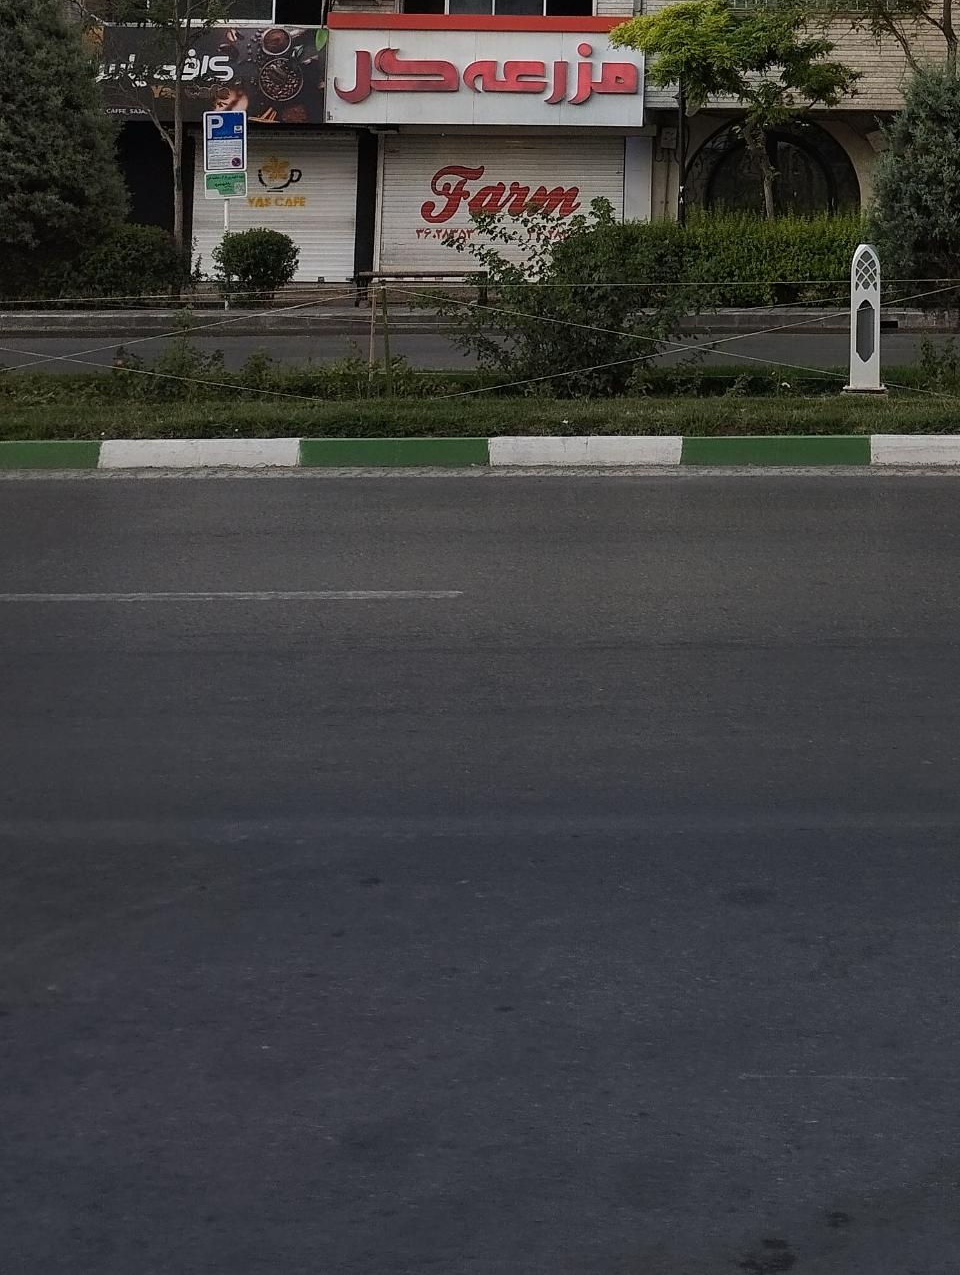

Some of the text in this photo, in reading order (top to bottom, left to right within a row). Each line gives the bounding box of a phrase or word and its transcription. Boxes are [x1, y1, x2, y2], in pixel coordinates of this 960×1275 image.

[462, 42, 639, 106] مزرعه
[206, 114, 224, 140] P
[274, 196, 306, 207] CAFE
[420, 165, 582, 224] Farm
